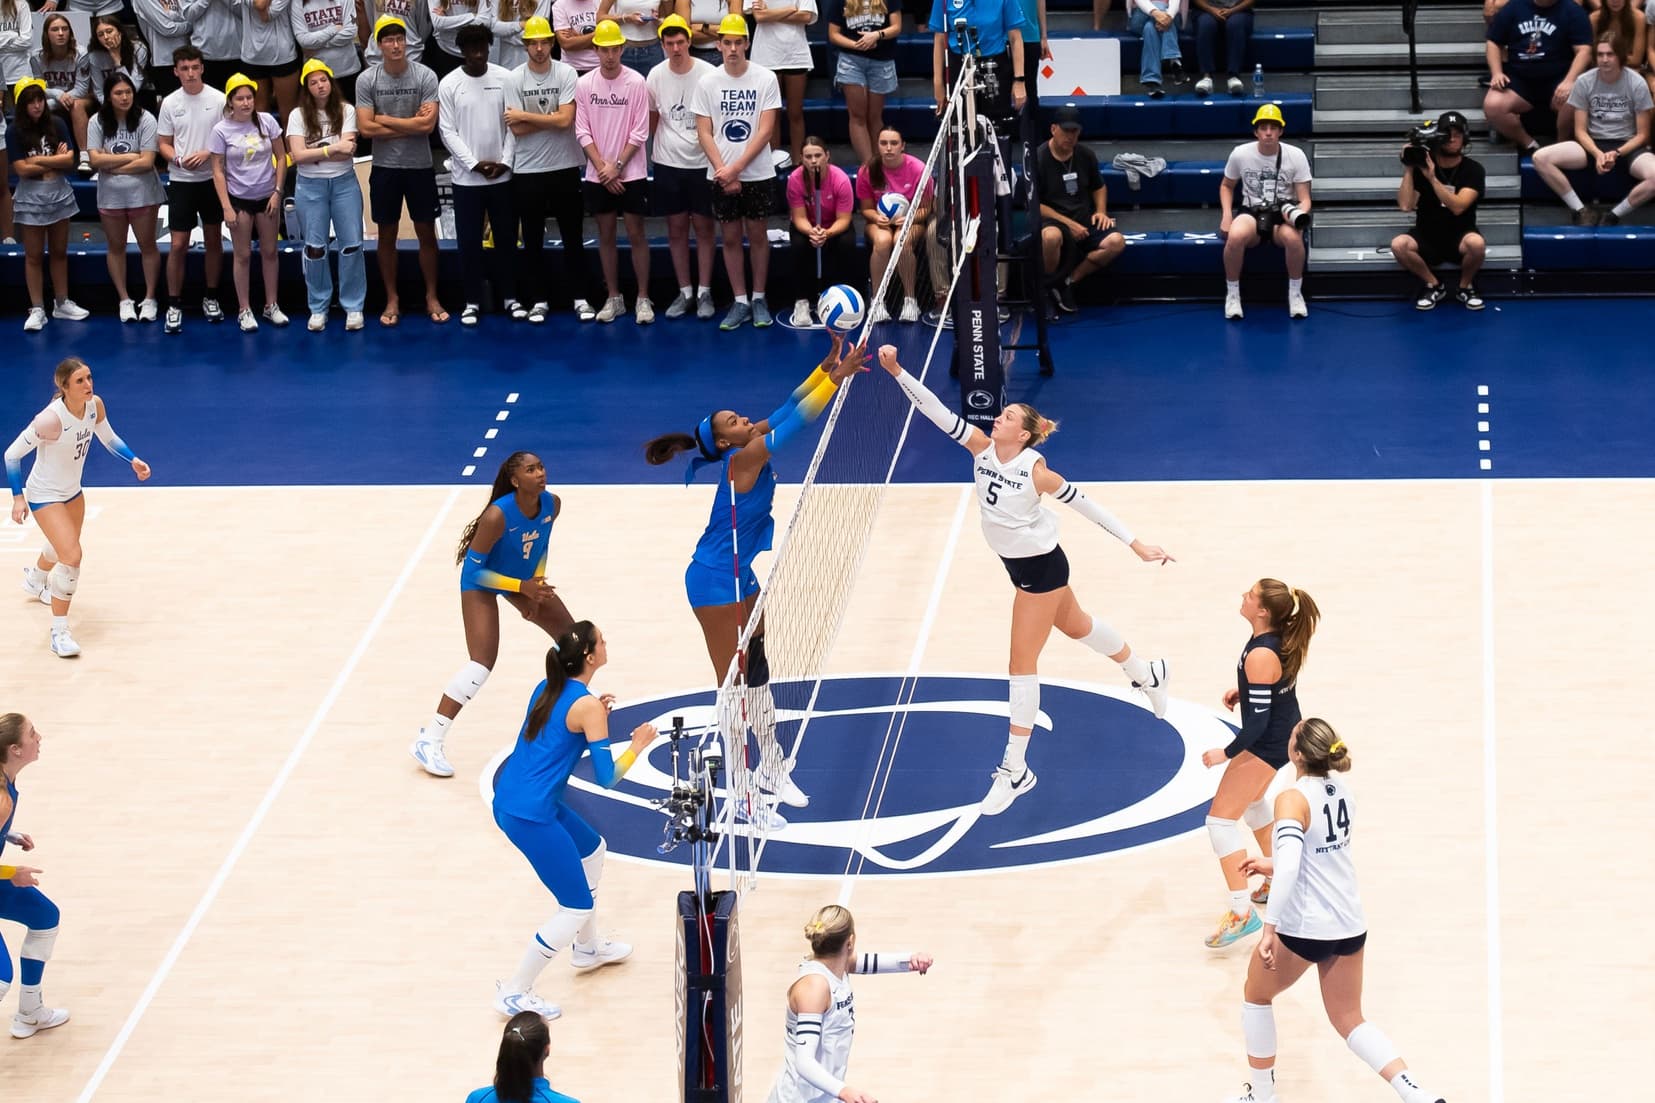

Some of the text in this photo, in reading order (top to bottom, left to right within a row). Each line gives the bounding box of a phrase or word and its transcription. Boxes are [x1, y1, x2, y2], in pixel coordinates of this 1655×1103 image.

[304, 6, 343, 23] STATE
[590, 93, 629, 106] Penn State
[722, 89, 757, 100] TEAM
[721, 101, 756, 112] REAM
[971, 309, 985, 380] PENN STATE
[74, 438, 90, 461] 30
[977, 466, 1024, 490] PENN STATE
[986, 481, 1003, 506] 5
[522, 541, 534, 560] 9
[1323, 798, 1350, 843] 14
